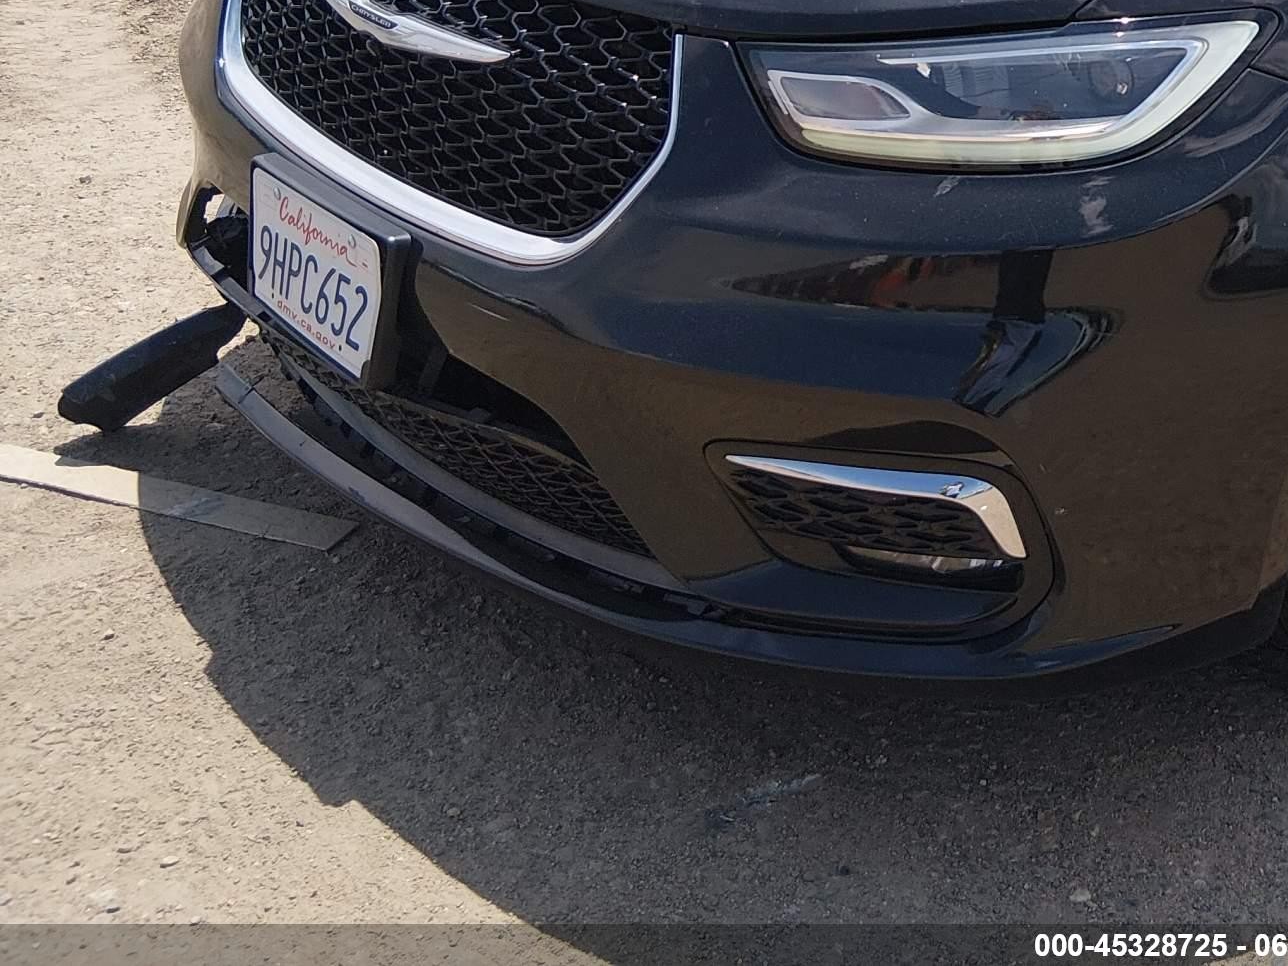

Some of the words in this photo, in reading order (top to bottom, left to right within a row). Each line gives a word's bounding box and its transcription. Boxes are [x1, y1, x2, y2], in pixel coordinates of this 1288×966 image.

[351, 4, 391, 28] CHRYSLER
[279, 196, 357, 268] California
[258, 225, 369, 352] 9HPC652
